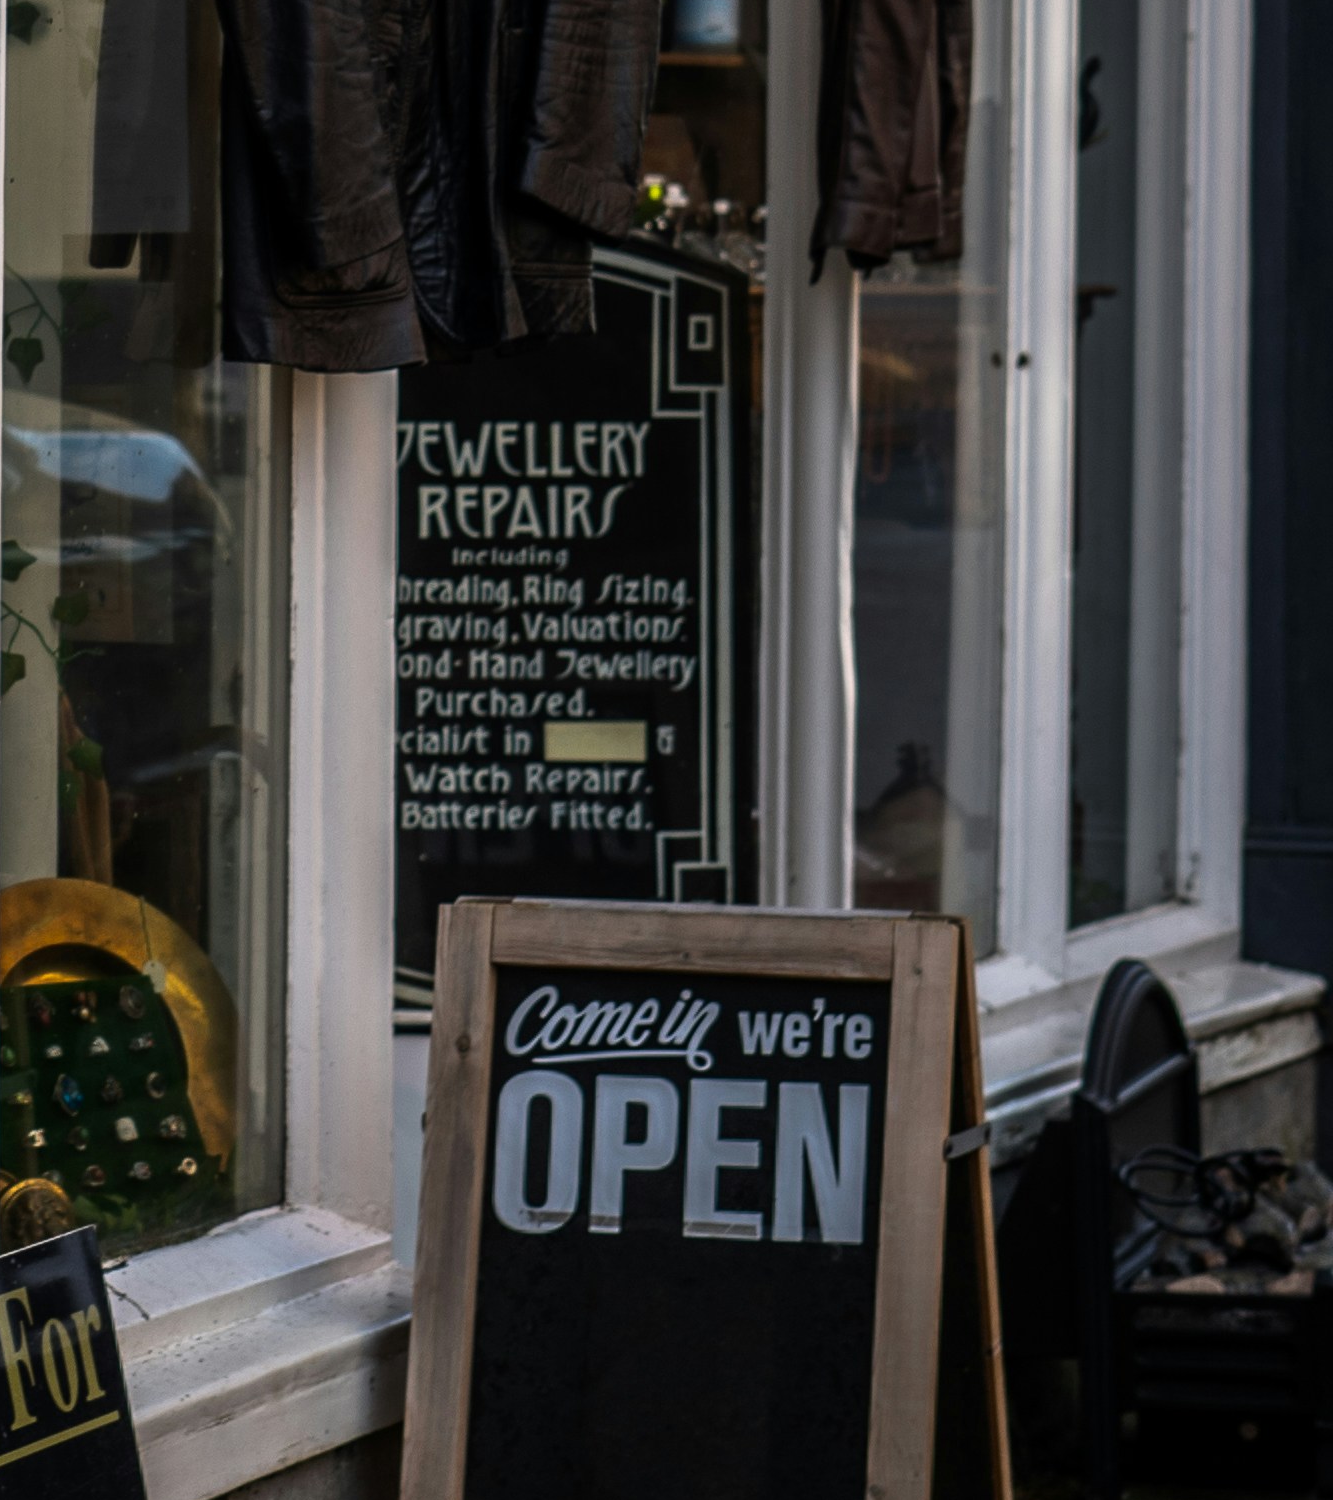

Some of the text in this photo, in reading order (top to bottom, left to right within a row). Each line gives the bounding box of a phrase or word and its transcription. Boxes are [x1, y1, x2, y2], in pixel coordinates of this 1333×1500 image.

[418, 484, 630, 540] REPAIRS
[522, 573, 584, 613] Ring
[556, 649, 696, 692] Jewellery
[396, 724, 490, 755] cialist
[504, 724, 532, 756] in
[404, 762, 653, 794] Watch Repairs.
[401, 800, 654, 831] Batteries Fitted.
[504, 985, 874, 1071] Come in we're
[492, 1069, 871, 1245] OPEN
